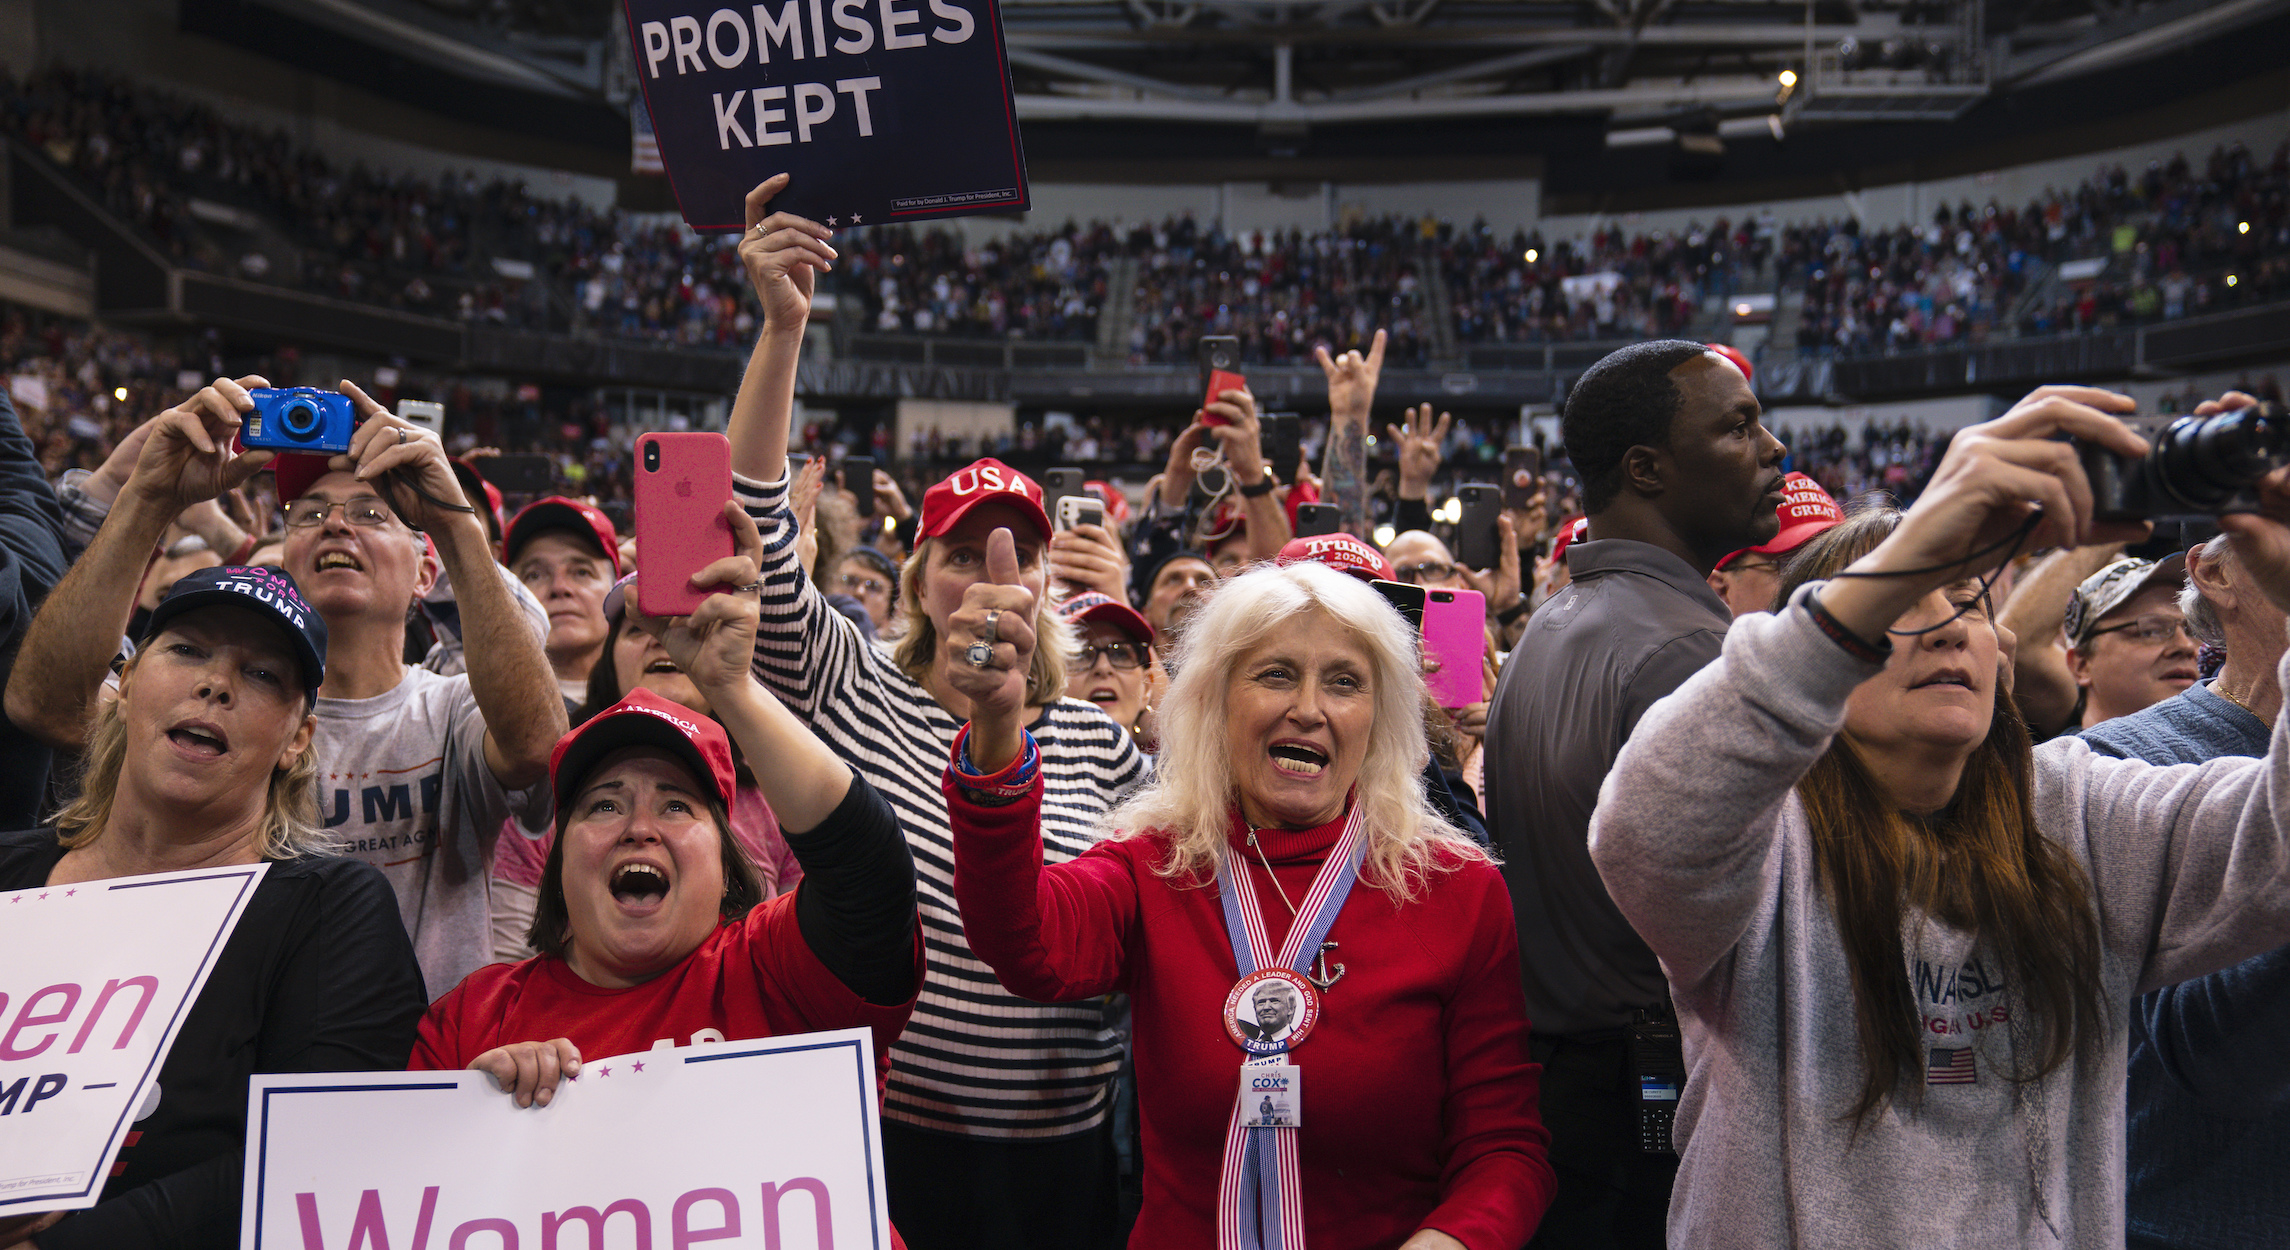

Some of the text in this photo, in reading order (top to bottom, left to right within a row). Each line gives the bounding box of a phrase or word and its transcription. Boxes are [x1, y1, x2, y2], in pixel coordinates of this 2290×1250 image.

[641, 0, 975, 79] PROMISES
[713, 76, 881, 150] KEPT
[949, 195, 966, 203] Trump
[975, 191, 1002, 200] President,
[951, 466, 1028, 497] USA
[1777, 491, 1835, 508] MERIC
[1791, 504, 1836, 519] GREAT
[1305, 539, 1383, 571] Trump
[1334, 552, 1364, 564] 2020
[226, 567, 312, 613] WOMEN
[255, 577, 287, 598] FOR
[215, 581, 305, 629] TRUMP
[344, 837, 397, 853] GREAT
[1261, 971, 1292, 980] LEADER
[1292, 977, 1306, 990] AND
[1231, 980, 1252, 1004] NEEDED
[1303, 990, 1314, 1006] GOD
[0, 975, 159, 1061] en
[1228, 1006, 1243, 1038] AMERICA
[1302, 1009, 1314, 1028] SENT
[1290, 1029, 1305, 1041] HIM
[1246, 1039, 1285, 1051] TRUMP
[1252, 1078, 1281, 1088] COX
